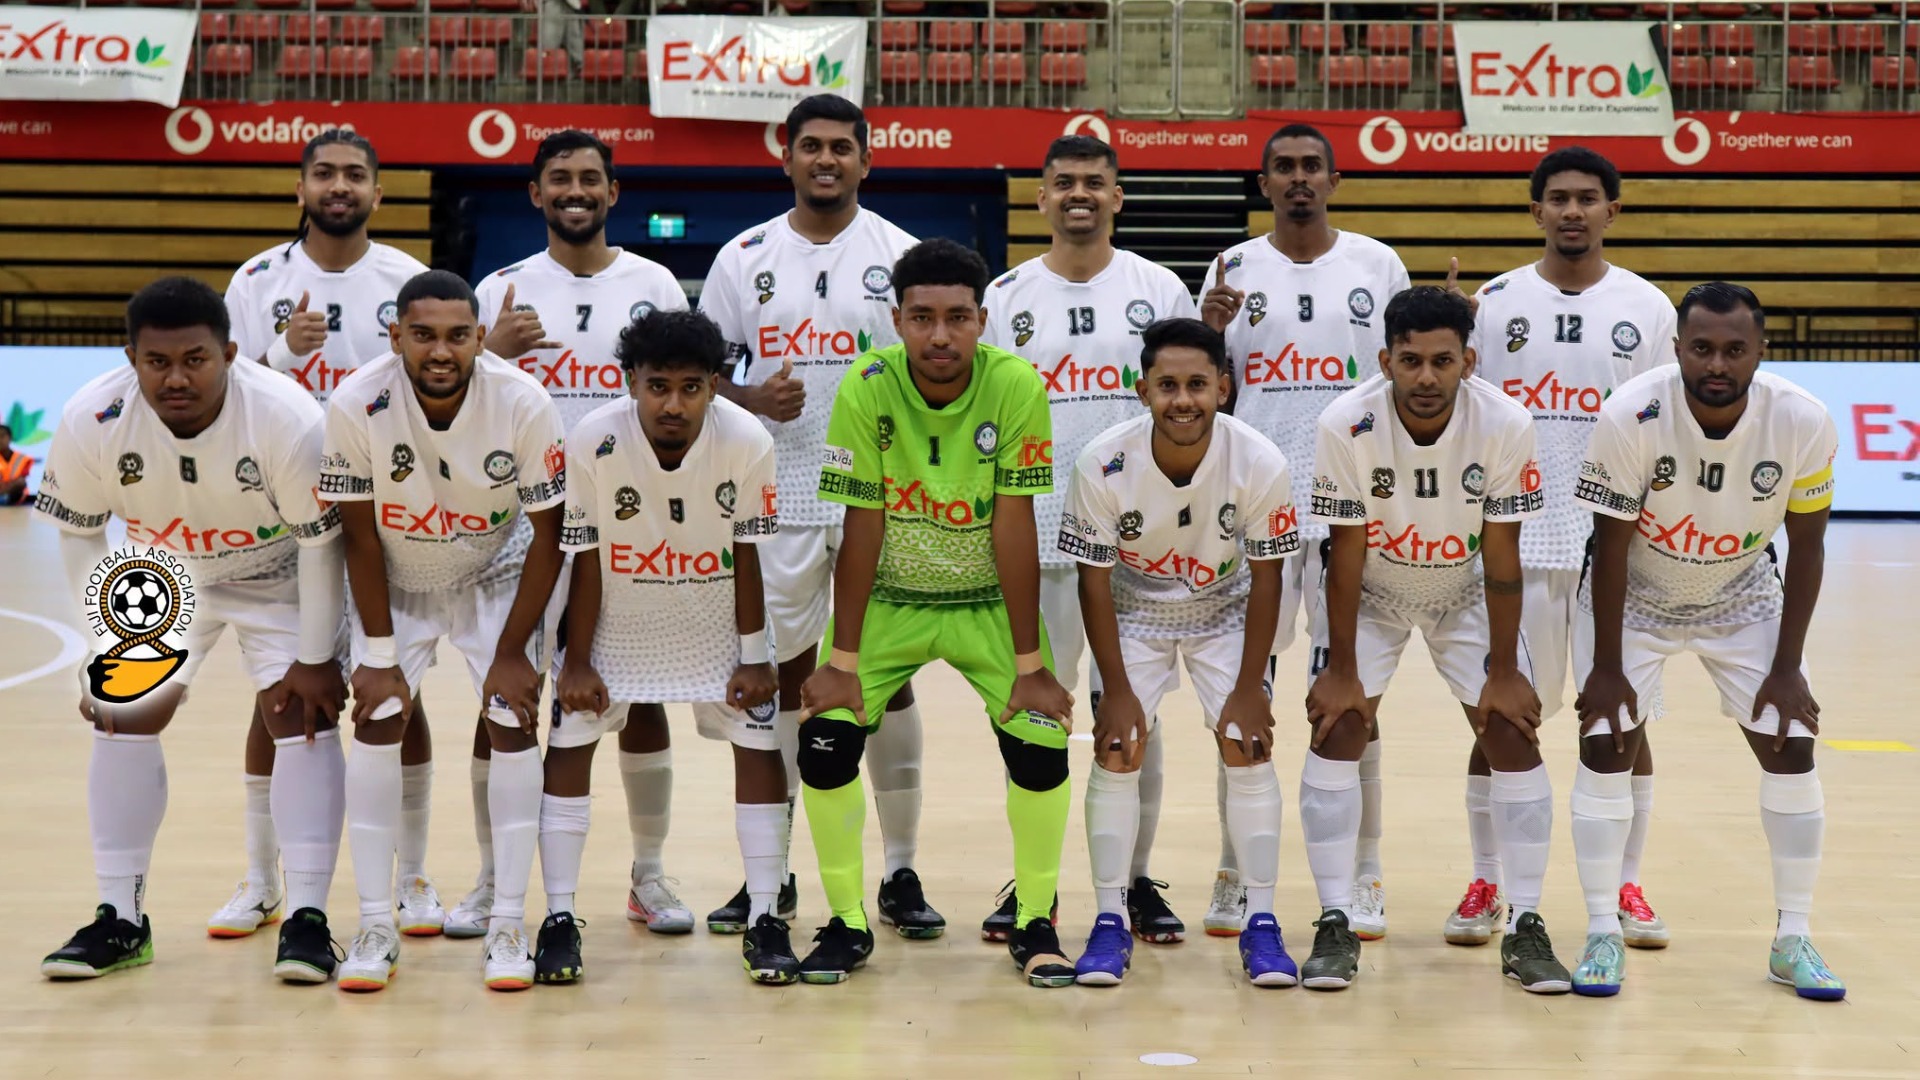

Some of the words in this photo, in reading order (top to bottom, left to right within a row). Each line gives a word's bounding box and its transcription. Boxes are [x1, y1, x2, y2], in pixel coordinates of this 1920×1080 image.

[662, 35, 811, 87] Extra
[1470, 43, 1622, 98] Extra
[1503, 103, 1545, 112] Welcome
[1549, 103, 1558, 112] to
[1561, 104, 1575, 112] the
[1578, 104, 1602, 112] Extra
[1606, 104, 1659, 113] Experience
[22, 121, 52, 134] can
[598, 129, 621, 142] we
[624, 128, 654, 142] can
[867, 121, 952, 149] afone
[1116, 128, 1189, 149] Together
[1192, 131, 1214, 146] we
[1218, 131, 1248, 146] can
[1413, 131, 1549, 152] vodafone
[1718, 130, 1792, 151] Together
[1795, 134, 1819, 148] we
[1822, 133, 1852, 148] can
[815, 270, 829, 299] 4
[326, 303, 342, 332] 2
[576, 304, 592, 332] 7
[1067, 306, 1095, 336] 13
[1298, 293, 1314, 322] 3
[759, 317, 855, 359] Extra
[1555, 314, 1582, 343] 12
[289, 352, 358, 392] xtr
[518, 349, 622, 389] Extra
[1033, 353, 1120, 392] xtra
[1244, 342, 1344, 385] Extra
[1110, 393, 1141, 401] Experienc
[1262, 385, 1291, 393] Welcome
[1503, 370, 1602, 413] Extra
[928, 436, 940, 466] 1
[1414, 467, 1439, 498] 11
[1697, 457, 1725, 493] 10
[382, 503, 488, 536] Extra
[960, 523, 992, 533] Experien
[1636, 507, 1741, 557] Extra
[1366, 519, 1466, 561] Extra
[611, 539, 719, 577] Extra
[1118, 547, 1215, 586] Extra
[632, 577, 665, 585] Welcome
